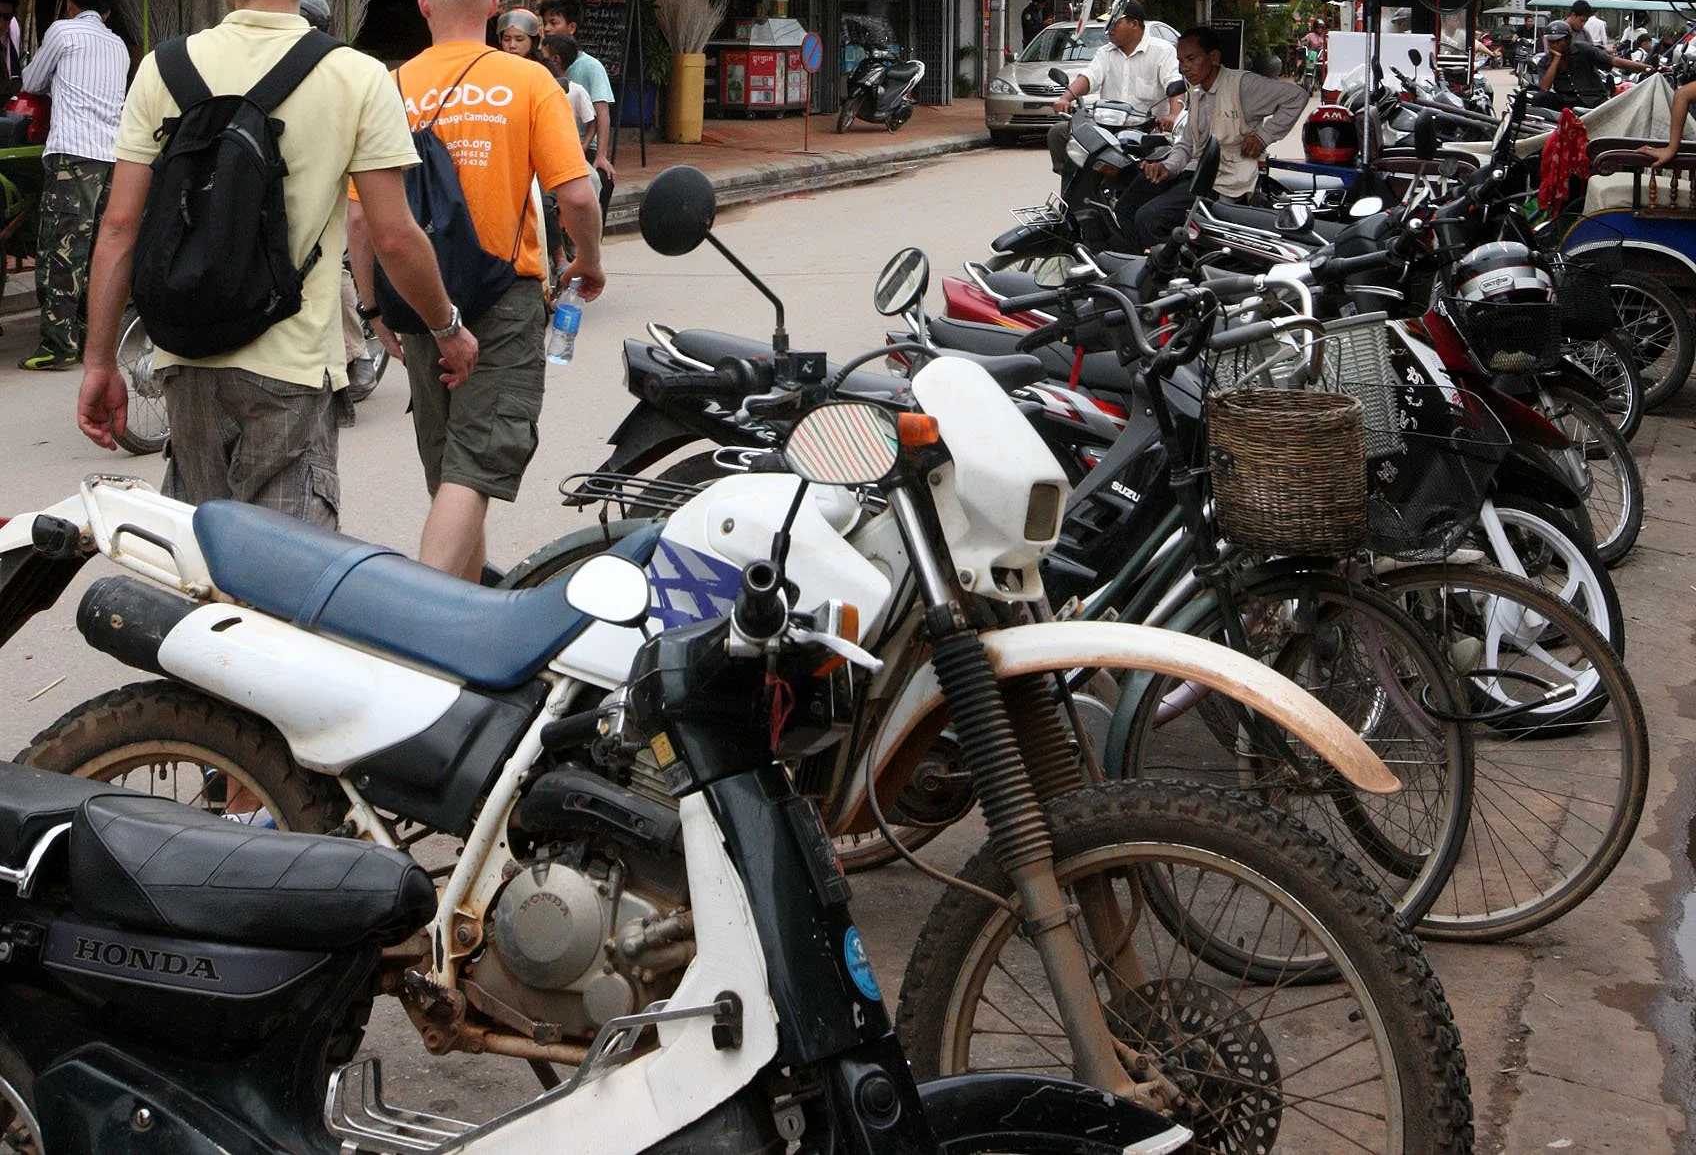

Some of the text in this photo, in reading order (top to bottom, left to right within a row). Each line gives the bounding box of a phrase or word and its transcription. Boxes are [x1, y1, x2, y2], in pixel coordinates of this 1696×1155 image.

[405, 84, 513, 116] ACODO
[463, 111, 508, 125] Cambodia
[520, 892, 570, 918] HONDA
[74, 936, 221, 982] HONDA
